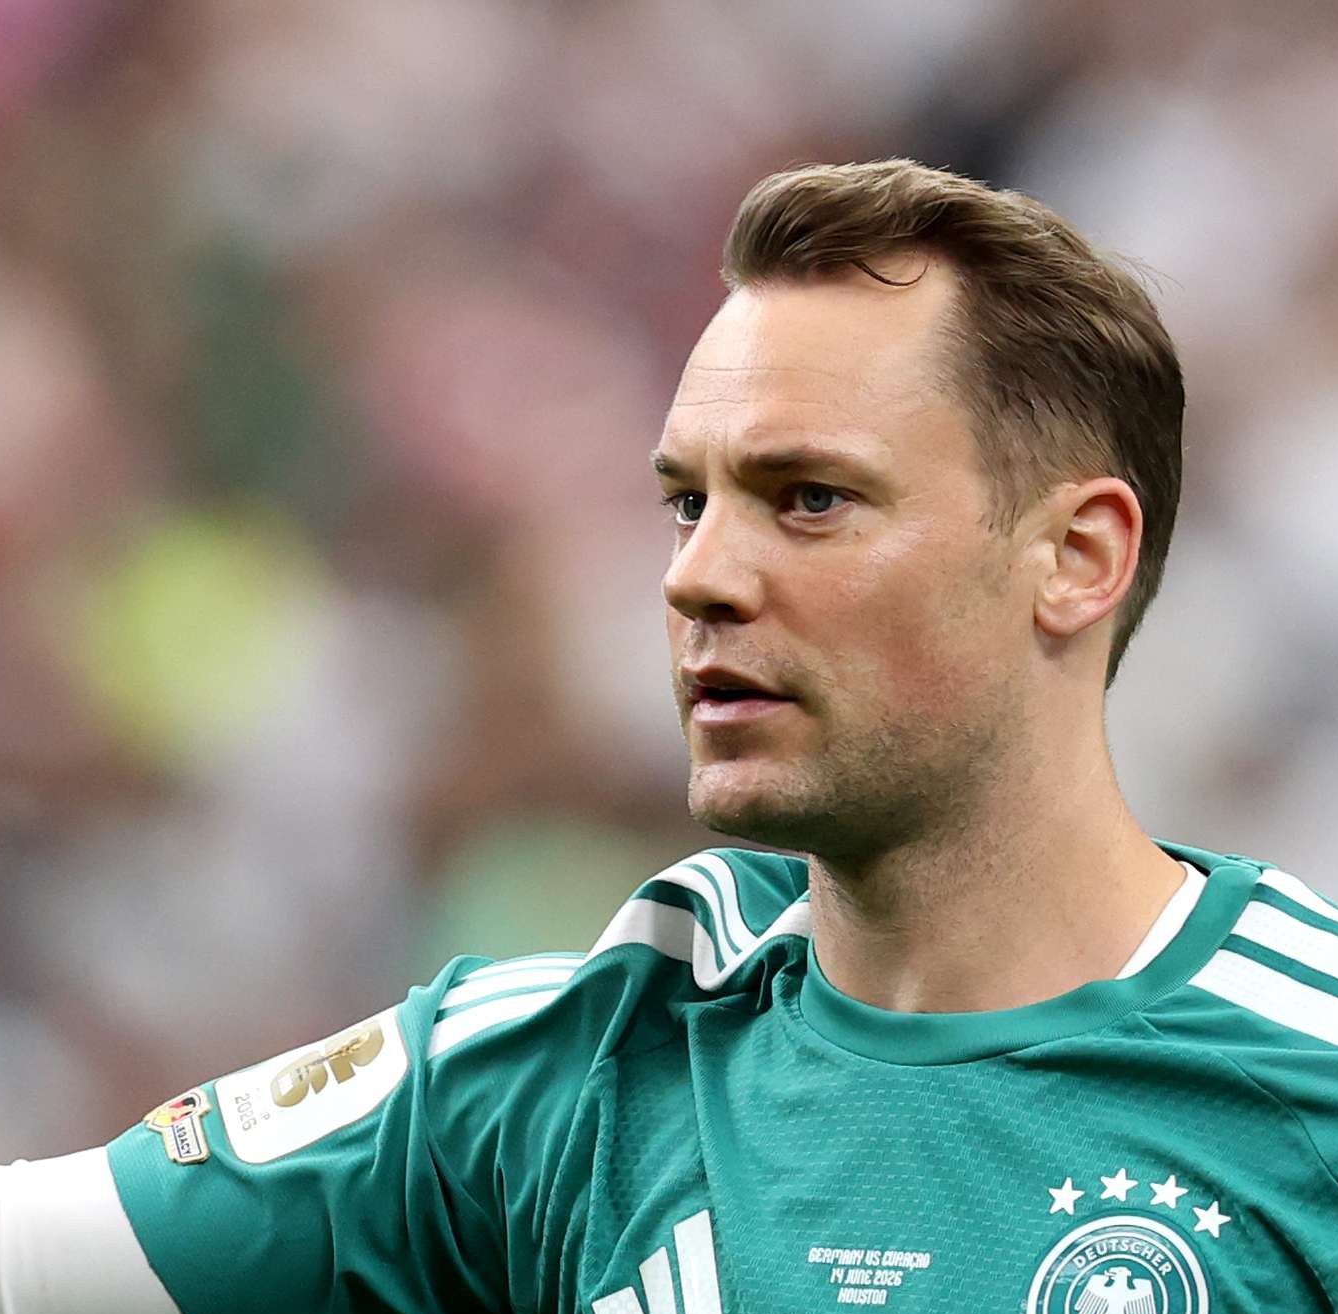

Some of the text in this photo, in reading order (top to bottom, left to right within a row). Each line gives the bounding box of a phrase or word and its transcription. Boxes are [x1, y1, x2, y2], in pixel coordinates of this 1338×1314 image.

[234, 1092, 258, 1132] 2026
[808, 1247, 865, 1265] GERMANY
[882, 1251, 931, 1270] CURAÇAO
[1072, 1238, 1172, 1276] DEUTSCHER
[830, 1268, 904, 1286] 14 JUNE 2026
[837, 1287, 888, 1304] HOUSTON
